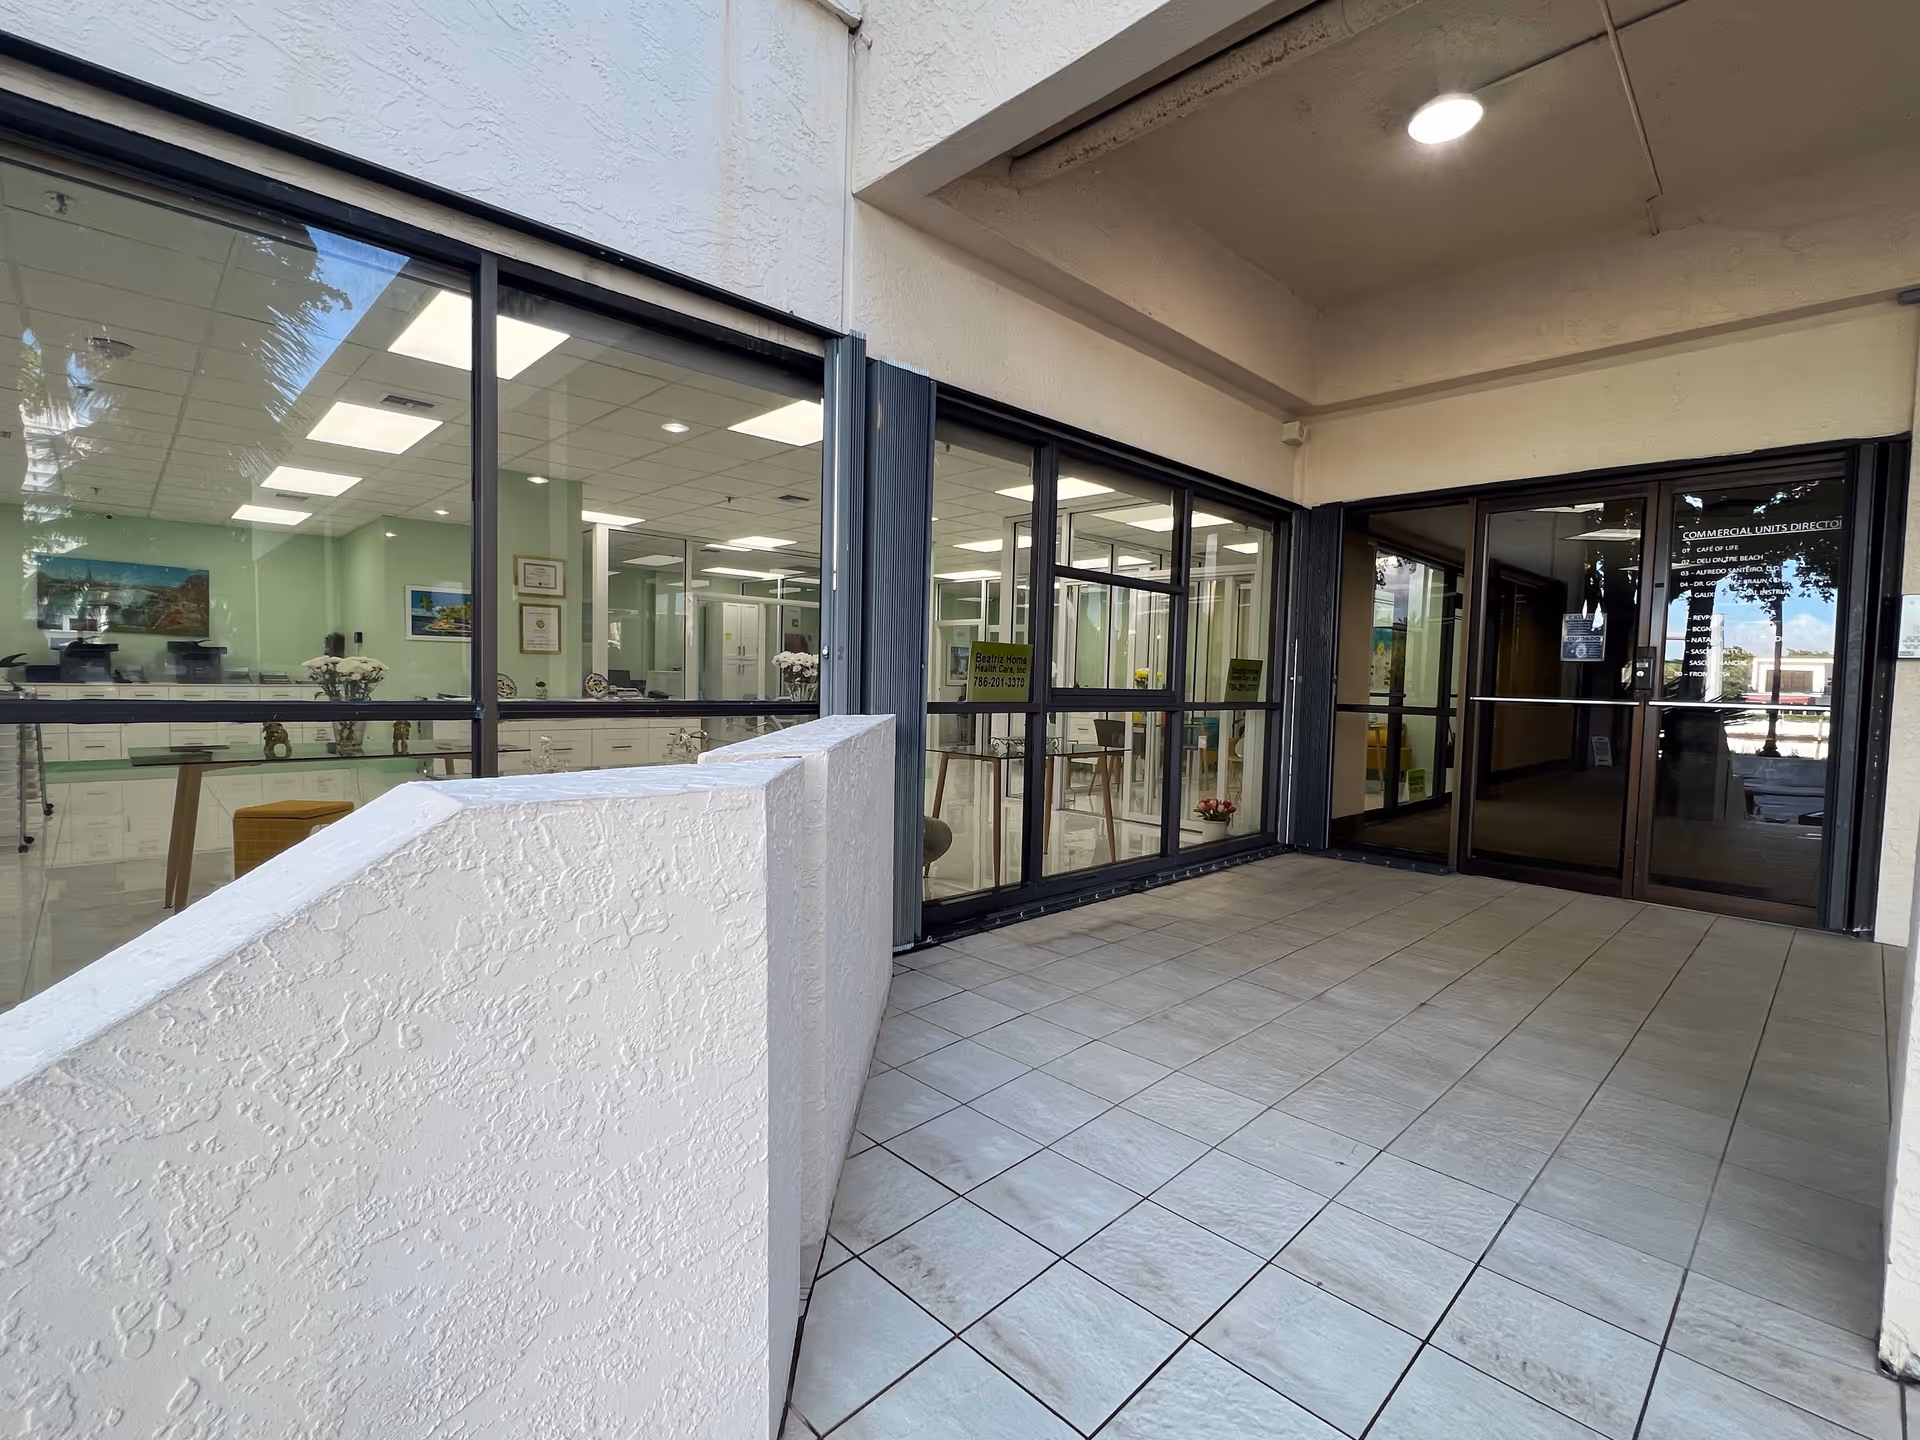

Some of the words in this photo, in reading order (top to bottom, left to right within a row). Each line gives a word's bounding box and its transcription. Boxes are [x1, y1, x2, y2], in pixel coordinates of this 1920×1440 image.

[1682, 527, 1752, 540] COMMERCIAL
[1755, 523, 1788, 535] UNITS
[1790, 519, 1842, 531] DIRECTO
[1695, 568, 1727, 576] ALFREDO
[975, 652, 1004, 664] Beatriz
[1006, 654, 1028, 665] Home
[974, 663, 997, 673] Health
[973, 676, 1025, 688] 786-201-3370
